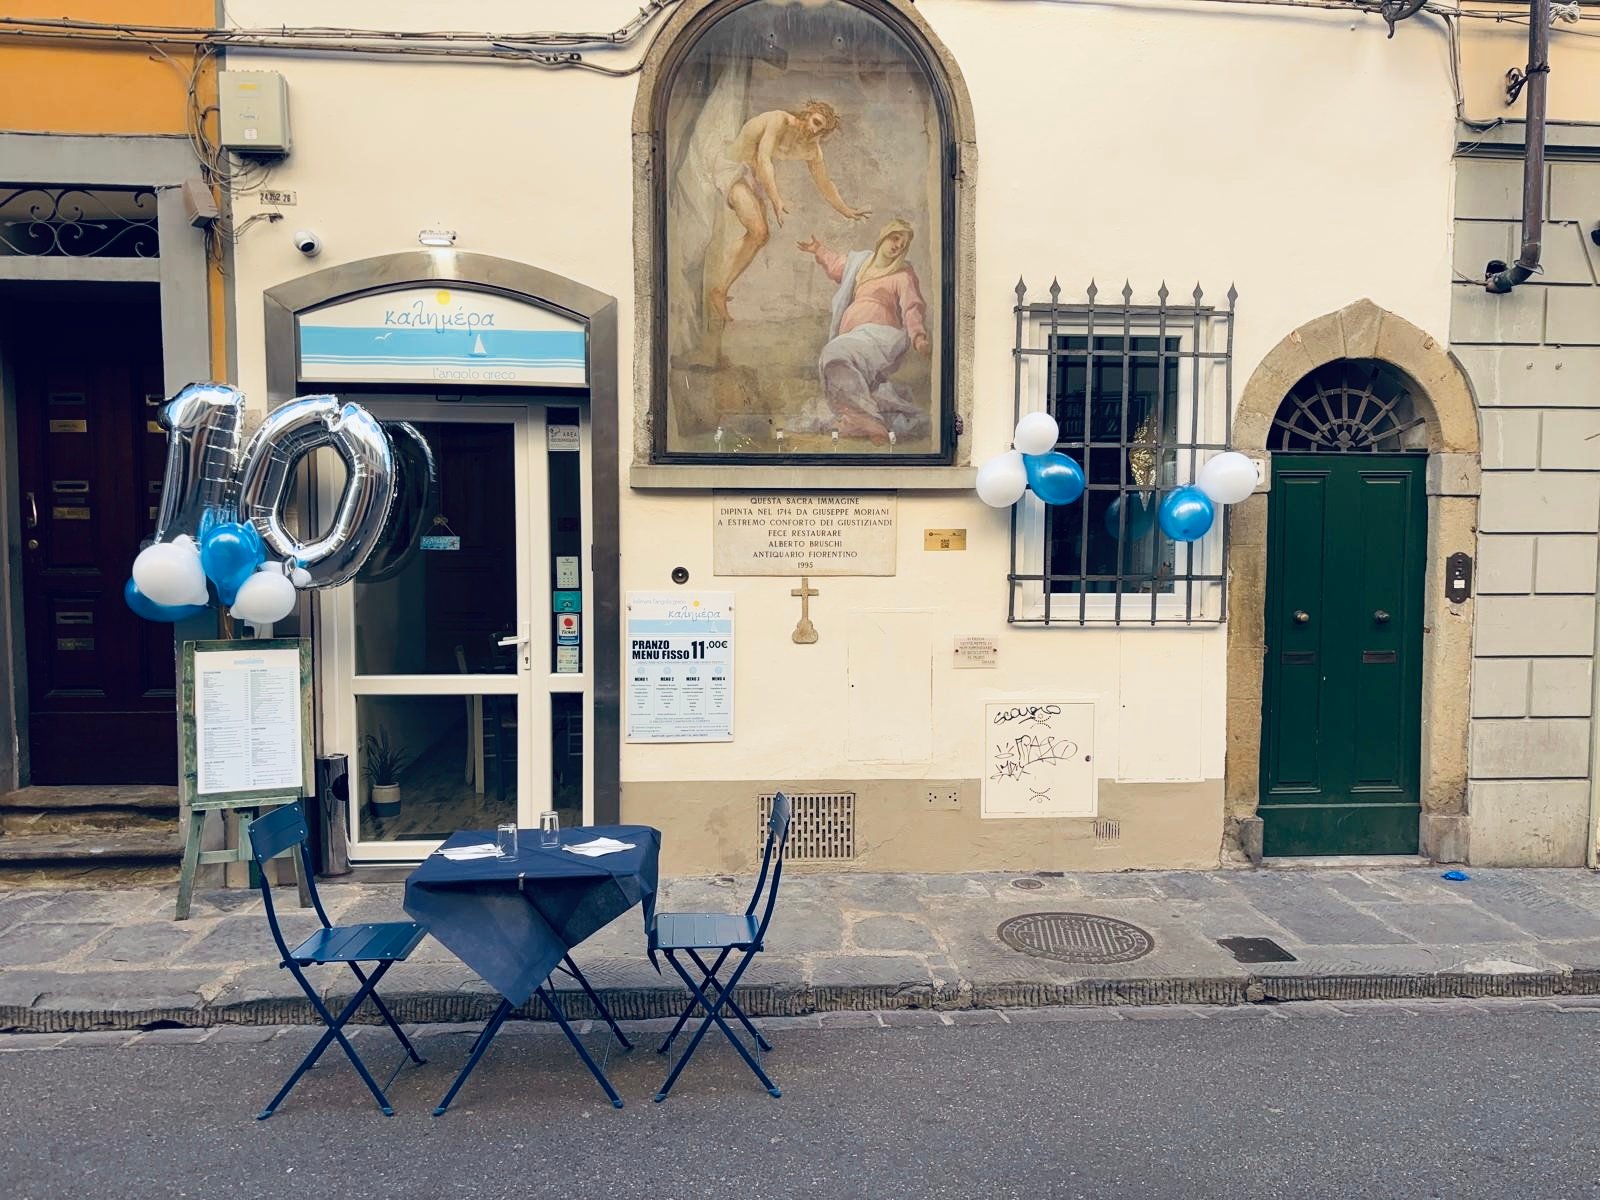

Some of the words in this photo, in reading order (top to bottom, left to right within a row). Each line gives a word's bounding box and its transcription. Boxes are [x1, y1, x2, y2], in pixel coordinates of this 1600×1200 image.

[432, 367, 479, 380] l'angolo
[485, 370, 516, 381] greco
[750, 497, 782, 505] QUESTA
[786, 497, 813, 505] SACRA
[817, 497, 860, 505] IMMAGINE
[720, 508, 753, 516] DIPINTA
[757, 508, 772, 516] NEL
[796, 508, 808, 516] DA
[812, 508, 849, 516] GIUSEPPE
[853, 508, 889, 516] MORIANI
[717, 519, 723, 527] A
[727, 519, 766, 527] ESTREMO
[769, 519, 816, 527] CONFORTO
[820, 519, 833, 527] DEI
[837, 519, 892, 527] GIUSTIZIANDI
[768, 540, 805, 548] ALBERTO
[809, 540, 842, 548] BRUSCHI
[752, 551, 805, 559] ANTIQUARIO
[808, 551, 858, 559] FIORENTINO
[797, 561, 814, 569] 1995
[632, 640, 670, 650] PRANZO
[632, 650, 660, 660] MENU
[662, 650, 690, 660] FISSO
